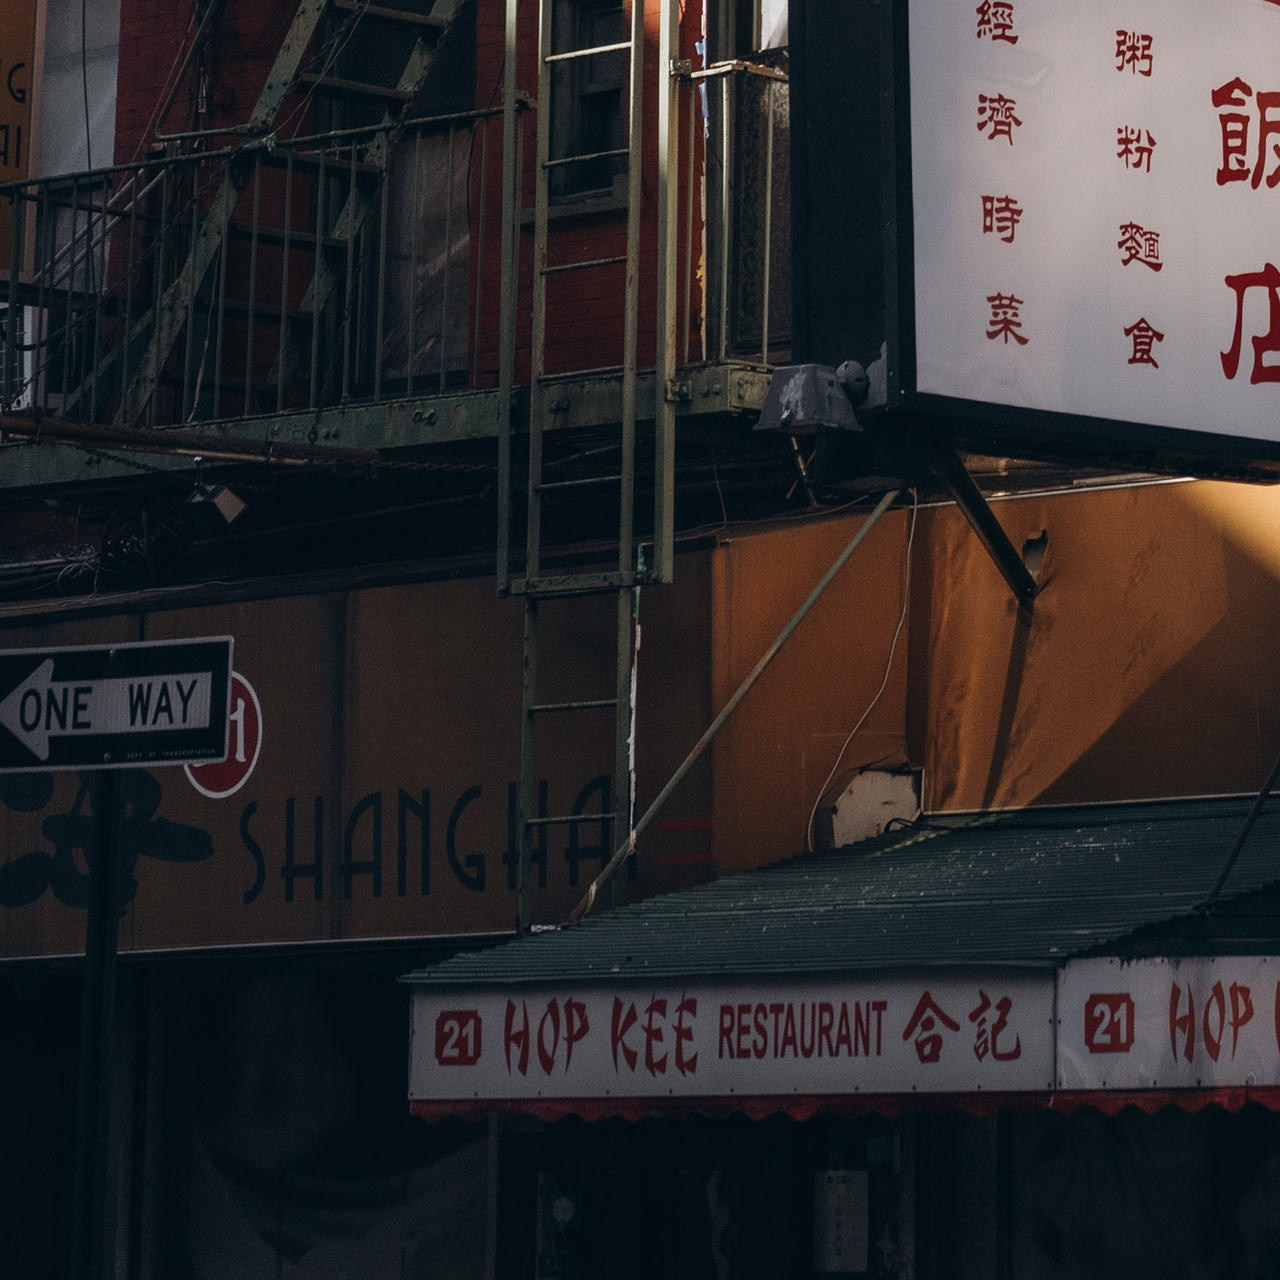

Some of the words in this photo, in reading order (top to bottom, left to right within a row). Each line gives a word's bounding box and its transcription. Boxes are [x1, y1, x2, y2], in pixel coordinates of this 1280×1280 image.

[19, 686, 93, 733] ONE
[128, 679, 198, 727] WAY
[441, 1017, 475, 1059] 21
[503, 996, 590, 1077] HOP
[611, 989, 698, 1078] KEE
[718, 1000, 888, 1060] RESTAURANT
[902, 989, 1022, 1064] 合記
[1090, 1002, 1128, 1045] 21
[1168, 980, 1254, 1064] HOP
